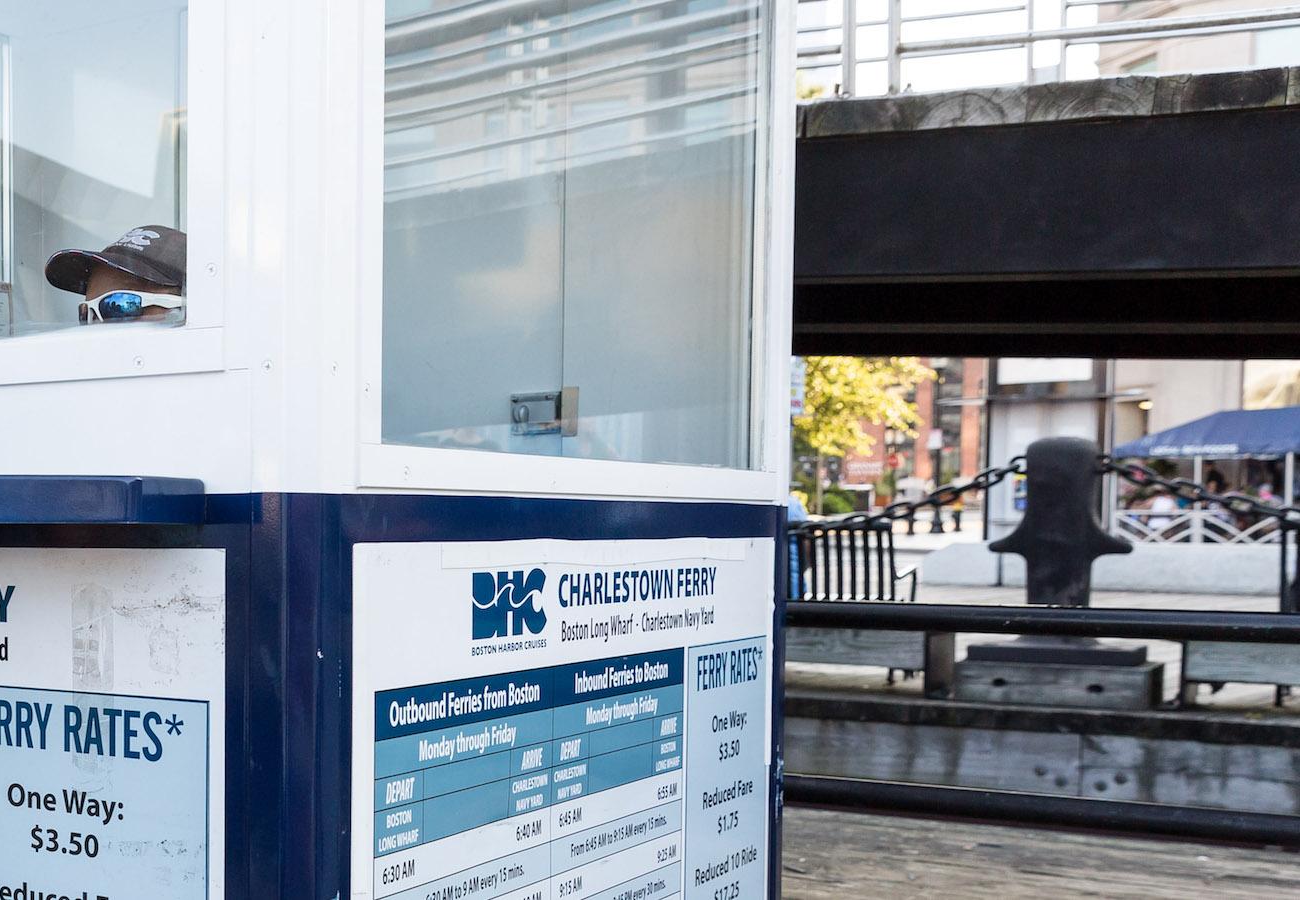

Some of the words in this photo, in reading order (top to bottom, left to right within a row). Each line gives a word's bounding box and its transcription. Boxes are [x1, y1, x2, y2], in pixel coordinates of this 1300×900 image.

[559, 570, 673, 608] CHARLESTOWN
[677, 567, 716, 597] FERRY
[472, 568, 547, 640] BHC
[561, 620, 588, 642] Boston
[591, 617, 609, 642] Long
[610, 613, 633, 636] Wharf
[642, 609, 682, 632] Charlestown
[684, 608, 700, 630] Navy
[700, 606, 714, 625] Yard
[471, 646, 497, 656] BOSTON
[498, 642, 523, 653] HARBOR
[524, 639, 547, 650] CRUISES
[575, 667, 609, 694] Inbound
[609, 664, 634, 688] Ferries
[635, 664, 643, 681] to
[644, 661, 668, 682] Boston
[697, 651, 727, 691] FERRY
[390, 692, 446, 727] Outbound
[448, 689, 482, 717] Ferries
[483, 685, 506, 710] from
[508, 682, 540, 706] Boston
[586, 703, 613, 725] Monday
[613, 698, 638, 720] through
[639, 694, 658, 716] Friday
[712, 715, 727, 733] One
[730, 710, 747, 730] Way:
[419, 735, 455, 761] Monday
[456, 727, 490, 753] through
[491, 723, 516, 747] Friday
[560, 738, 581, 761] DEPART
[719, 739, 740, 762] $3.50
[521, 747, 543, 771] ARRIVE
[385, 777, 415, 804] DEPART
[512, 773, 548, 794] CHARLESTOWN
[657, 786, 668, 800] 6:55
[669, 782, 677, 796] AM
[702, 781, 736, 810] Reduced
[737, 780, 753, 797] Fare
[7, 783, 56, 811] One
[62, 789, 124, 825] Way:
[559, 810, 571, 827] 6:45
[572, 807, 582, 822] AM
[386, 810, 412, 828] BOSTON
[516, 824, 530, 841] 6:40
[531, 820, 542, 836] AM
[717, 810, 738, 834] $1.75
[31, 825, 99, 858] $3.50
[378, 835, 396, 852] LONG
[396, 829, 419, 848] WHARF
[571, 843, 585, 858] From
[585, 837, 597, 852] 6:45
[597, 831, 606, 848] AM
[607, 833, 613, 844] to
[613, 827, 624, 843] 9:15
[624, 823, 633, 839] AM
[634, 822, 647, 836] every
[648, 816, 654, 830] 15
[657, 848, 668, 863] 9:25
[669, 844, 677, 858] AM
[695, 853, 729, 887] Reduced
[731, 852, 740, 870] 10
[741, 845, 757, 867] Ride
[382, 864, 400, 885] 6:30
[402, 859, 415, 879] AM
[454, 884, 461, 898] to
[463, 881, 467, 896] 9
[468, 877, 479, 894] AM
[481, 873, 498, 890] every
[499, 866, 507, 883] 15
[508, 862, 524, 880] mins.
[559, 880, 571, 897] 9:15
[573, 876, 582, 892] AM
